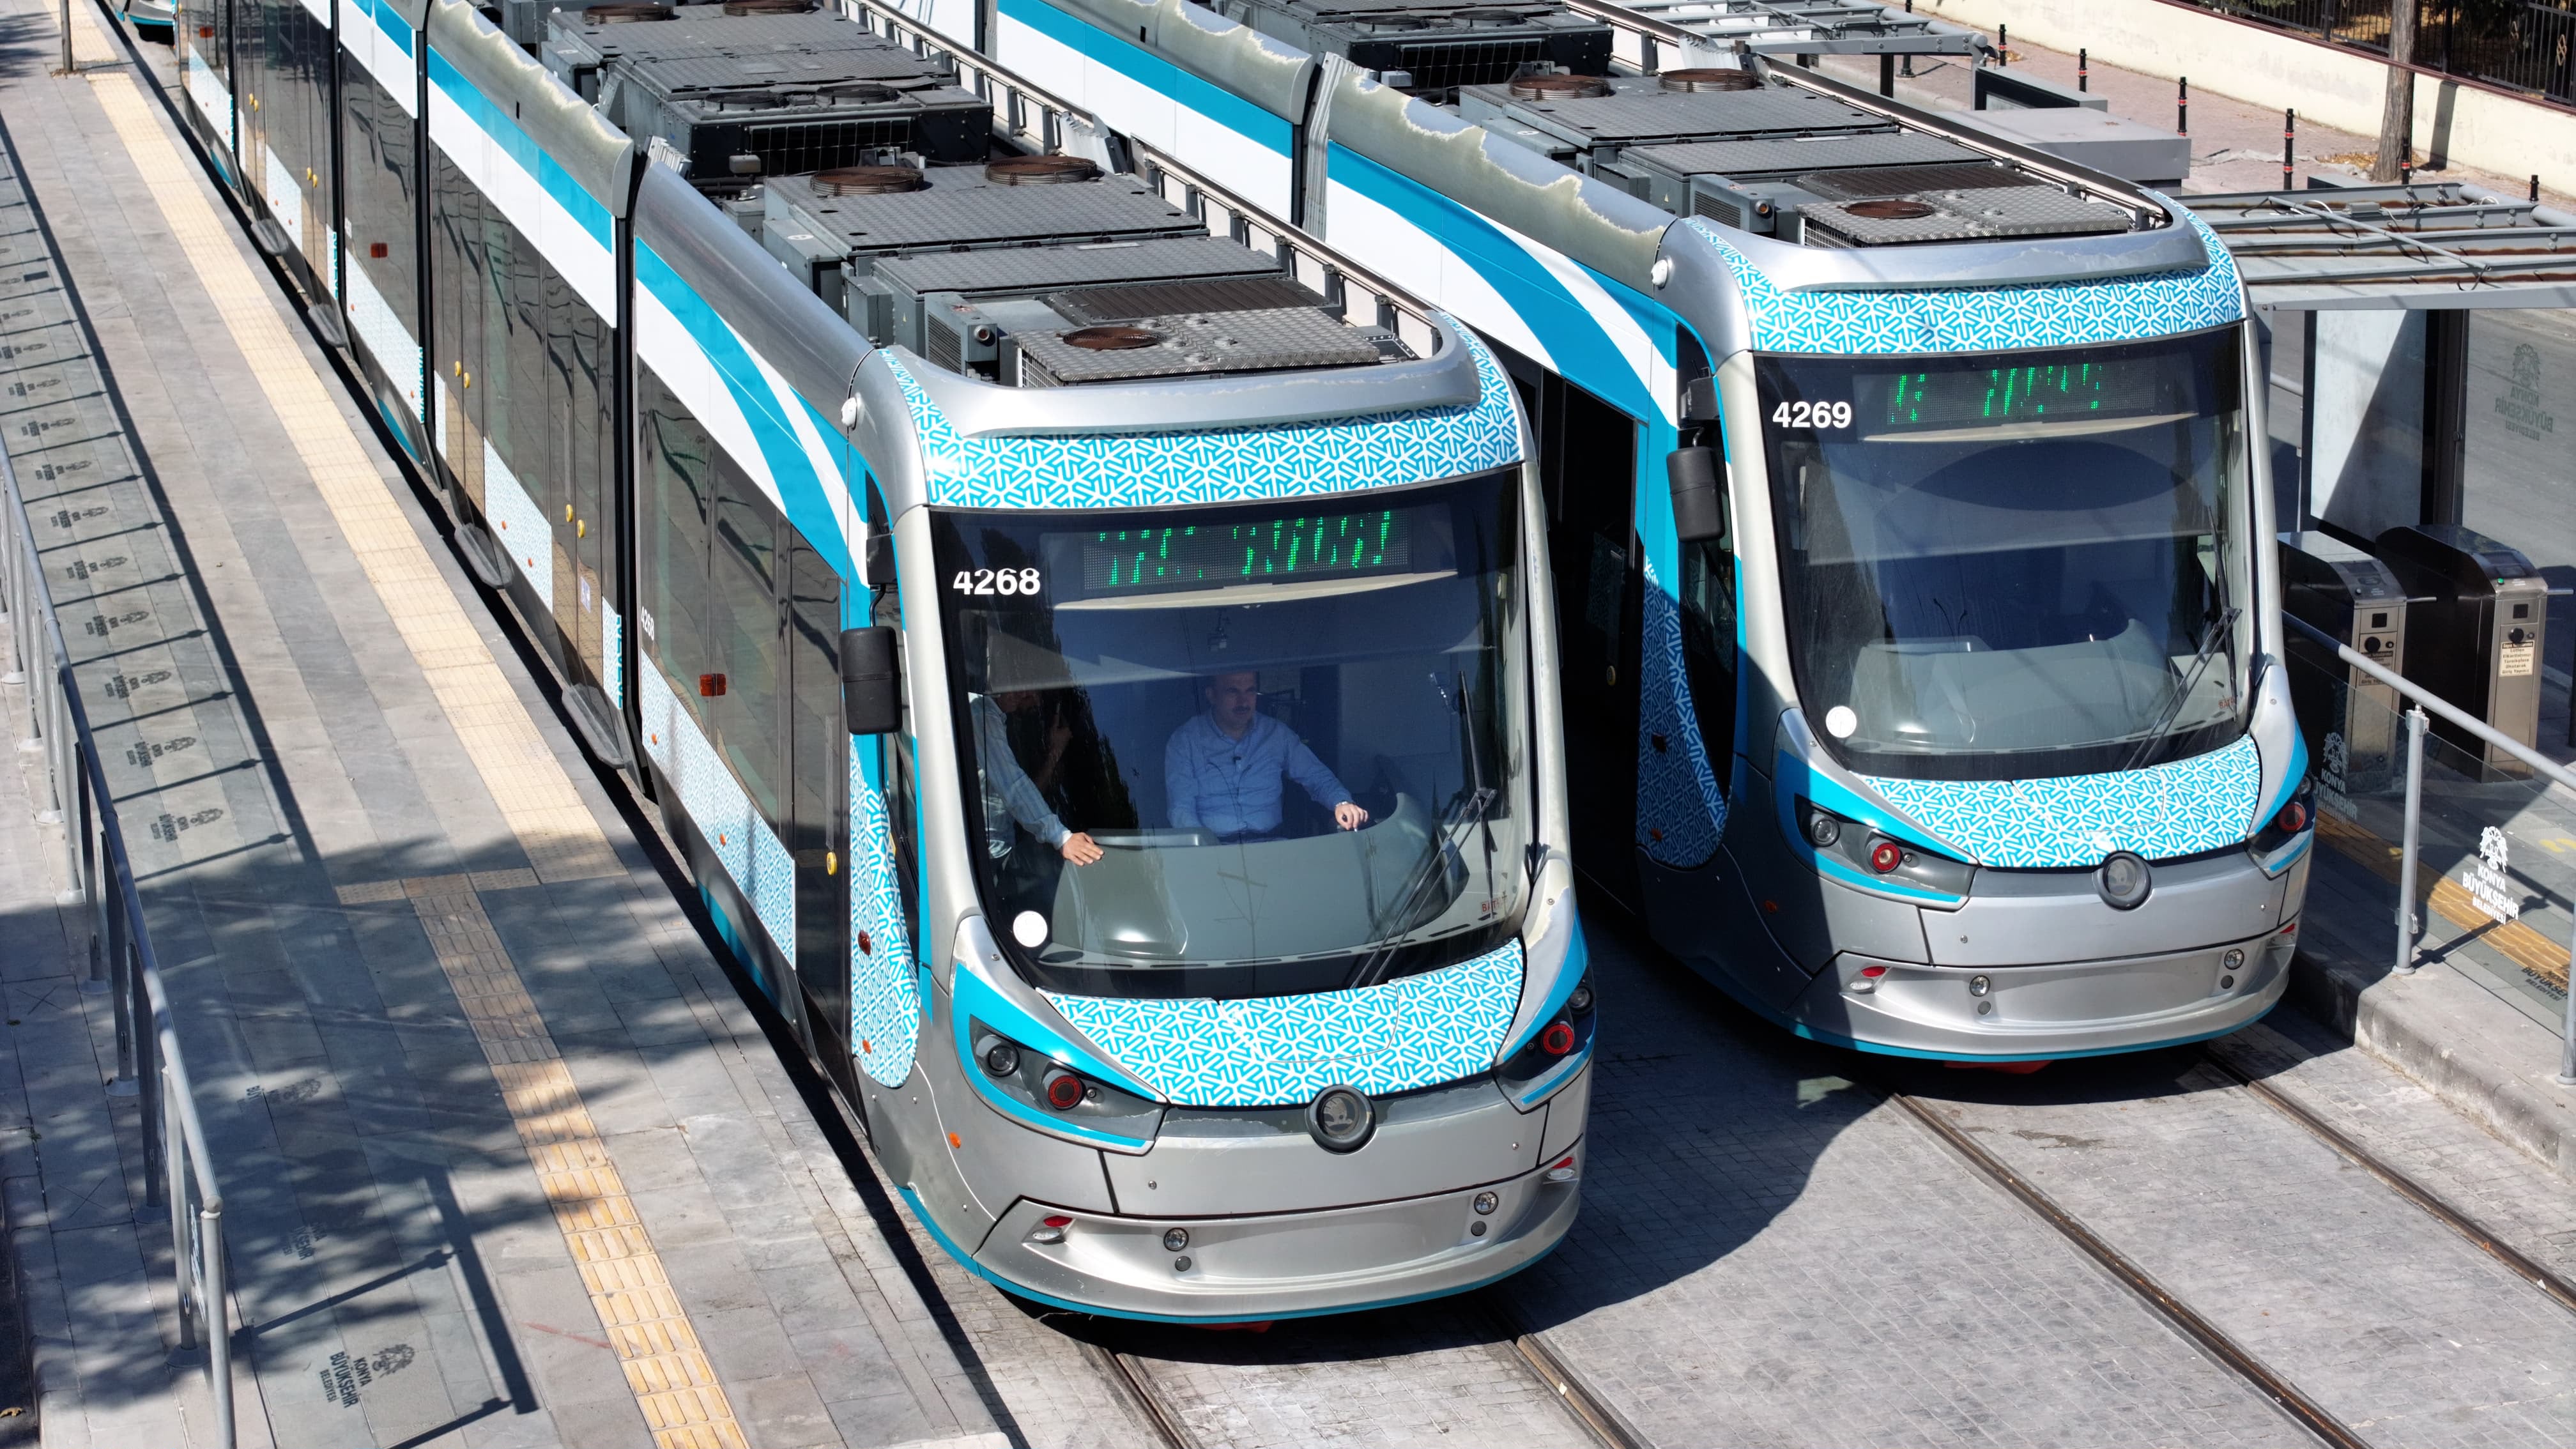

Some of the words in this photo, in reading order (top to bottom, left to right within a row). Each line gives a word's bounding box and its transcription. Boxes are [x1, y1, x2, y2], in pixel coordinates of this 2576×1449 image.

[1772, 401, 1851, 428] 4269
[953, 568, 1041, 595] 4268
[641, 606, 654, 641] 4268
[2321, 768, 2346, 795] KONYA
[2314, 777, 2358, 820] ÜYÜKŞEHİR
[2478, 863, 2506, 893] KONYA
[2462, 871, 2519, 921] BÜYÜKŞEHİR
[2472, 896, 2506, 925] BELEDİYESİ
[319, 1369, 339, 1403] BELEDİYESİ
[330, 1351, 360, 1408] BÜYÜKŞEHİR
[353, 1357, 372, 1387] KONYA
